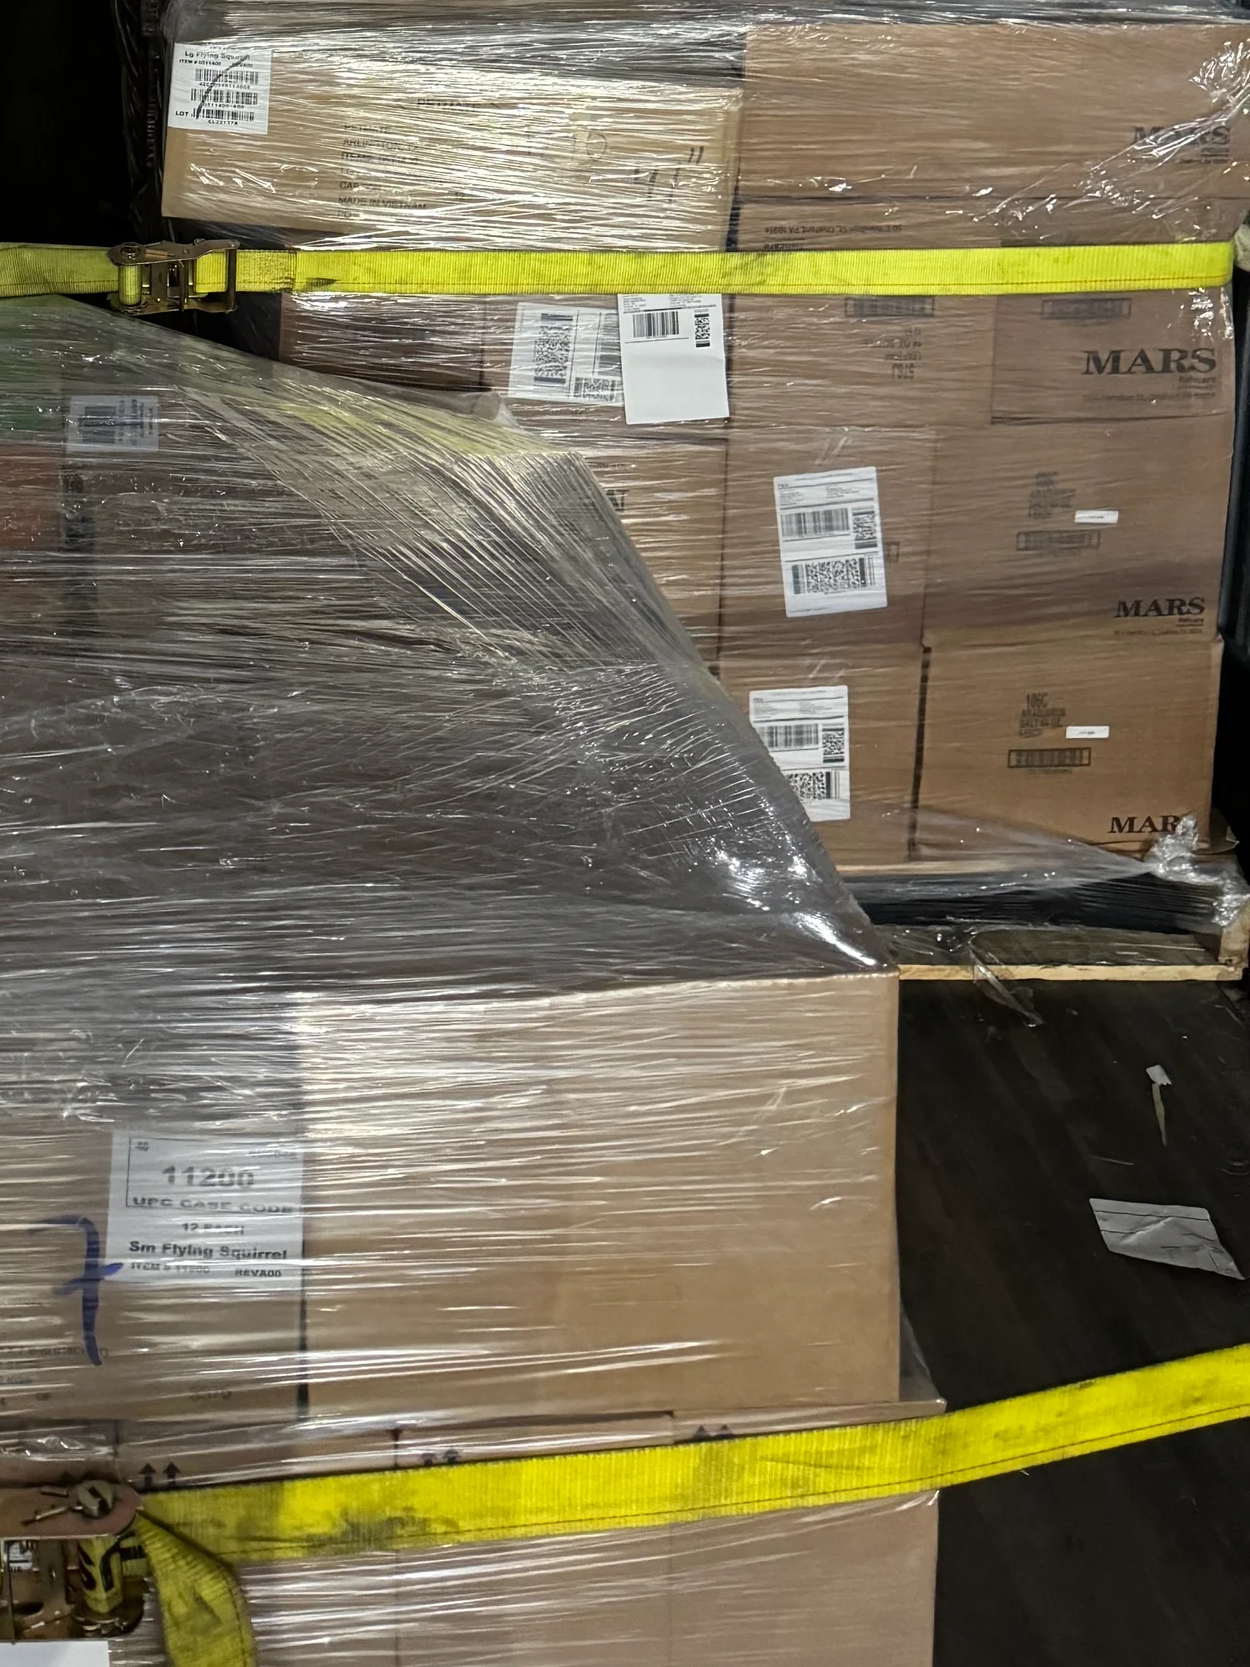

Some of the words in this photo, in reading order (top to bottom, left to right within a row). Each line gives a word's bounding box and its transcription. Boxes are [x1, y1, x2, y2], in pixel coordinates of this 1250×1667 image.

[196, 51, 219, 60] Flying
[1081, 347, 1217, 375] MARS
[1113, 597, 1206, 618] MARS
[1108, 814, 1183, 834] MAR
[162, 1164, 255, 1188] 11200
[132, 1196, 174, 1208] UPC
[180, 1199, 233, 1210] CASE
[239, 1203, 295, 1214] CODE
[128, 1240, 157, 1254] Sm
[161, 1242, 214, 1259] Flying
[219, 1245, 289, 1261] Squirrel
